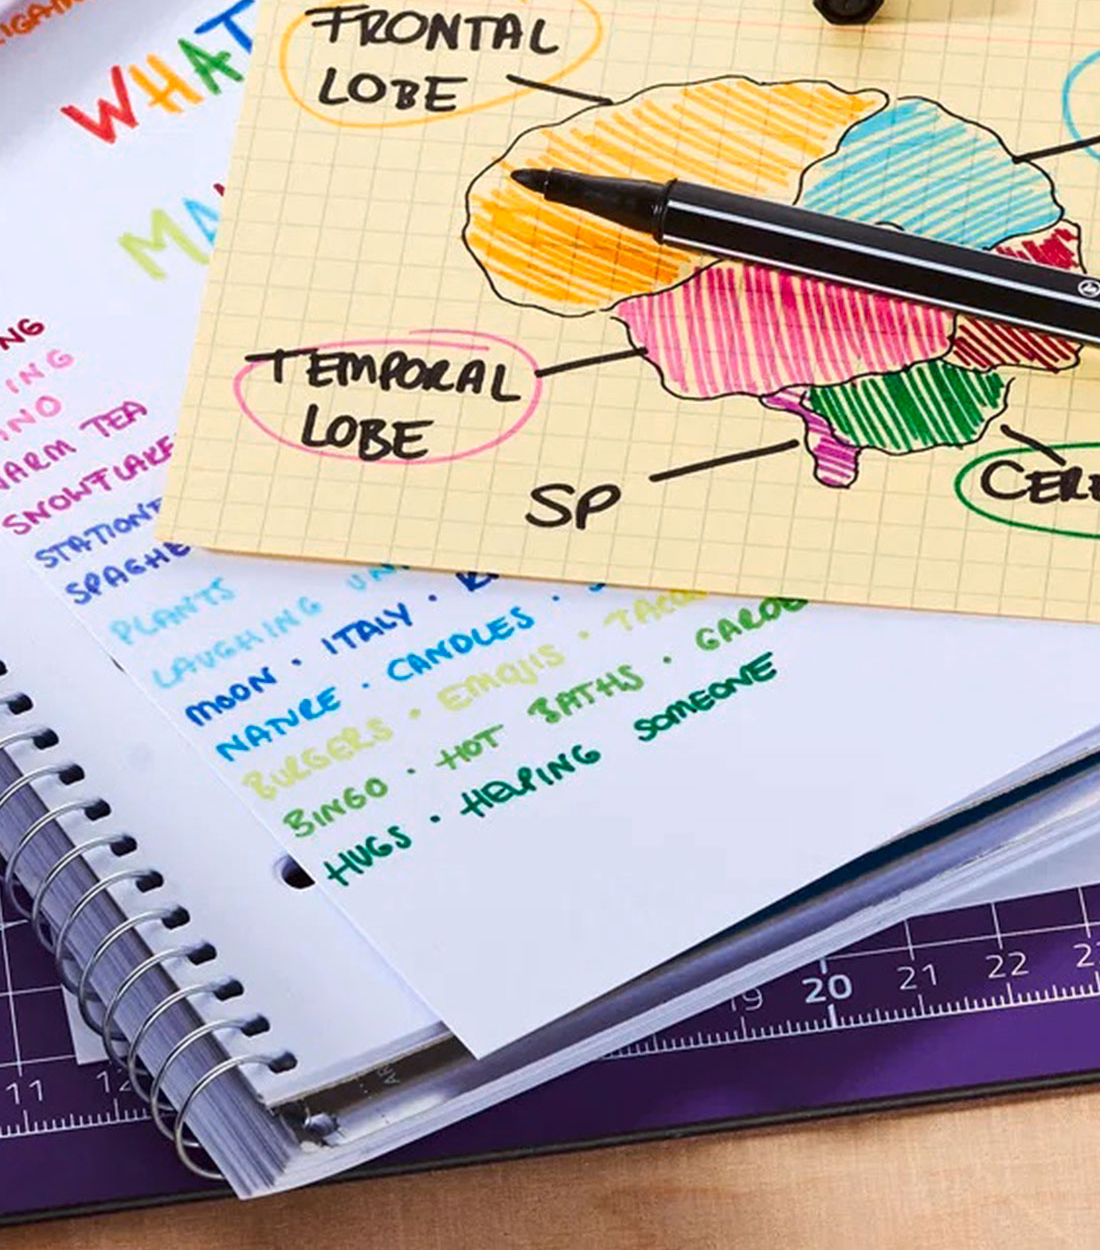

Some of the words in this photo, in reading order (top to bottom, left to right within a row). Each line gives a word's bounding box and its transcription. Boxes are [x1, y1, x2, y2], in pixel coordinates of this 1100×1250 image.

[304, 3, 560, 56] FRONTAL
[317, 66, 469, 113] LOBE
[0, 318, 45, 351] NG
[5, 349, 75, 393] ING
[244, 346, 522, 402] TEMPORAL
[79, 400, 148, 437] TEA
[300, 403, 435, 462] LOBE
[2, 433, 176, 535] SNOWFLAKE
[525, 482, 623, 531] SP
[65, 541, 191, 605] SPAGHE
[109, 577, 236, 645] PLANTS
[152, 596, 323, 689] LAUGHING
[386, 606, 535, 682] CANDLES
[185, 666, 278, 727] MOON
[321, 602, 413, 655] ITALY
[241, 717, 394, 801] BURGERS
[602, 588, 709, 632] TACO
[283, 777, 389, 838] BINGO
[436, 724, 504, 770] HOT
[526, 664, 644, 724] BATHS
[323, 825, 413, 887] HUGS
[460, 744, 601, 818] HELPING
[633, 651, 778, 741] SOMEONE
[6, 1078, 45, 1105] 11
[801, 973, 853, 1005] 20
[897, 964, 939, 991] 21
[985, 951, 1030, 979] 22
